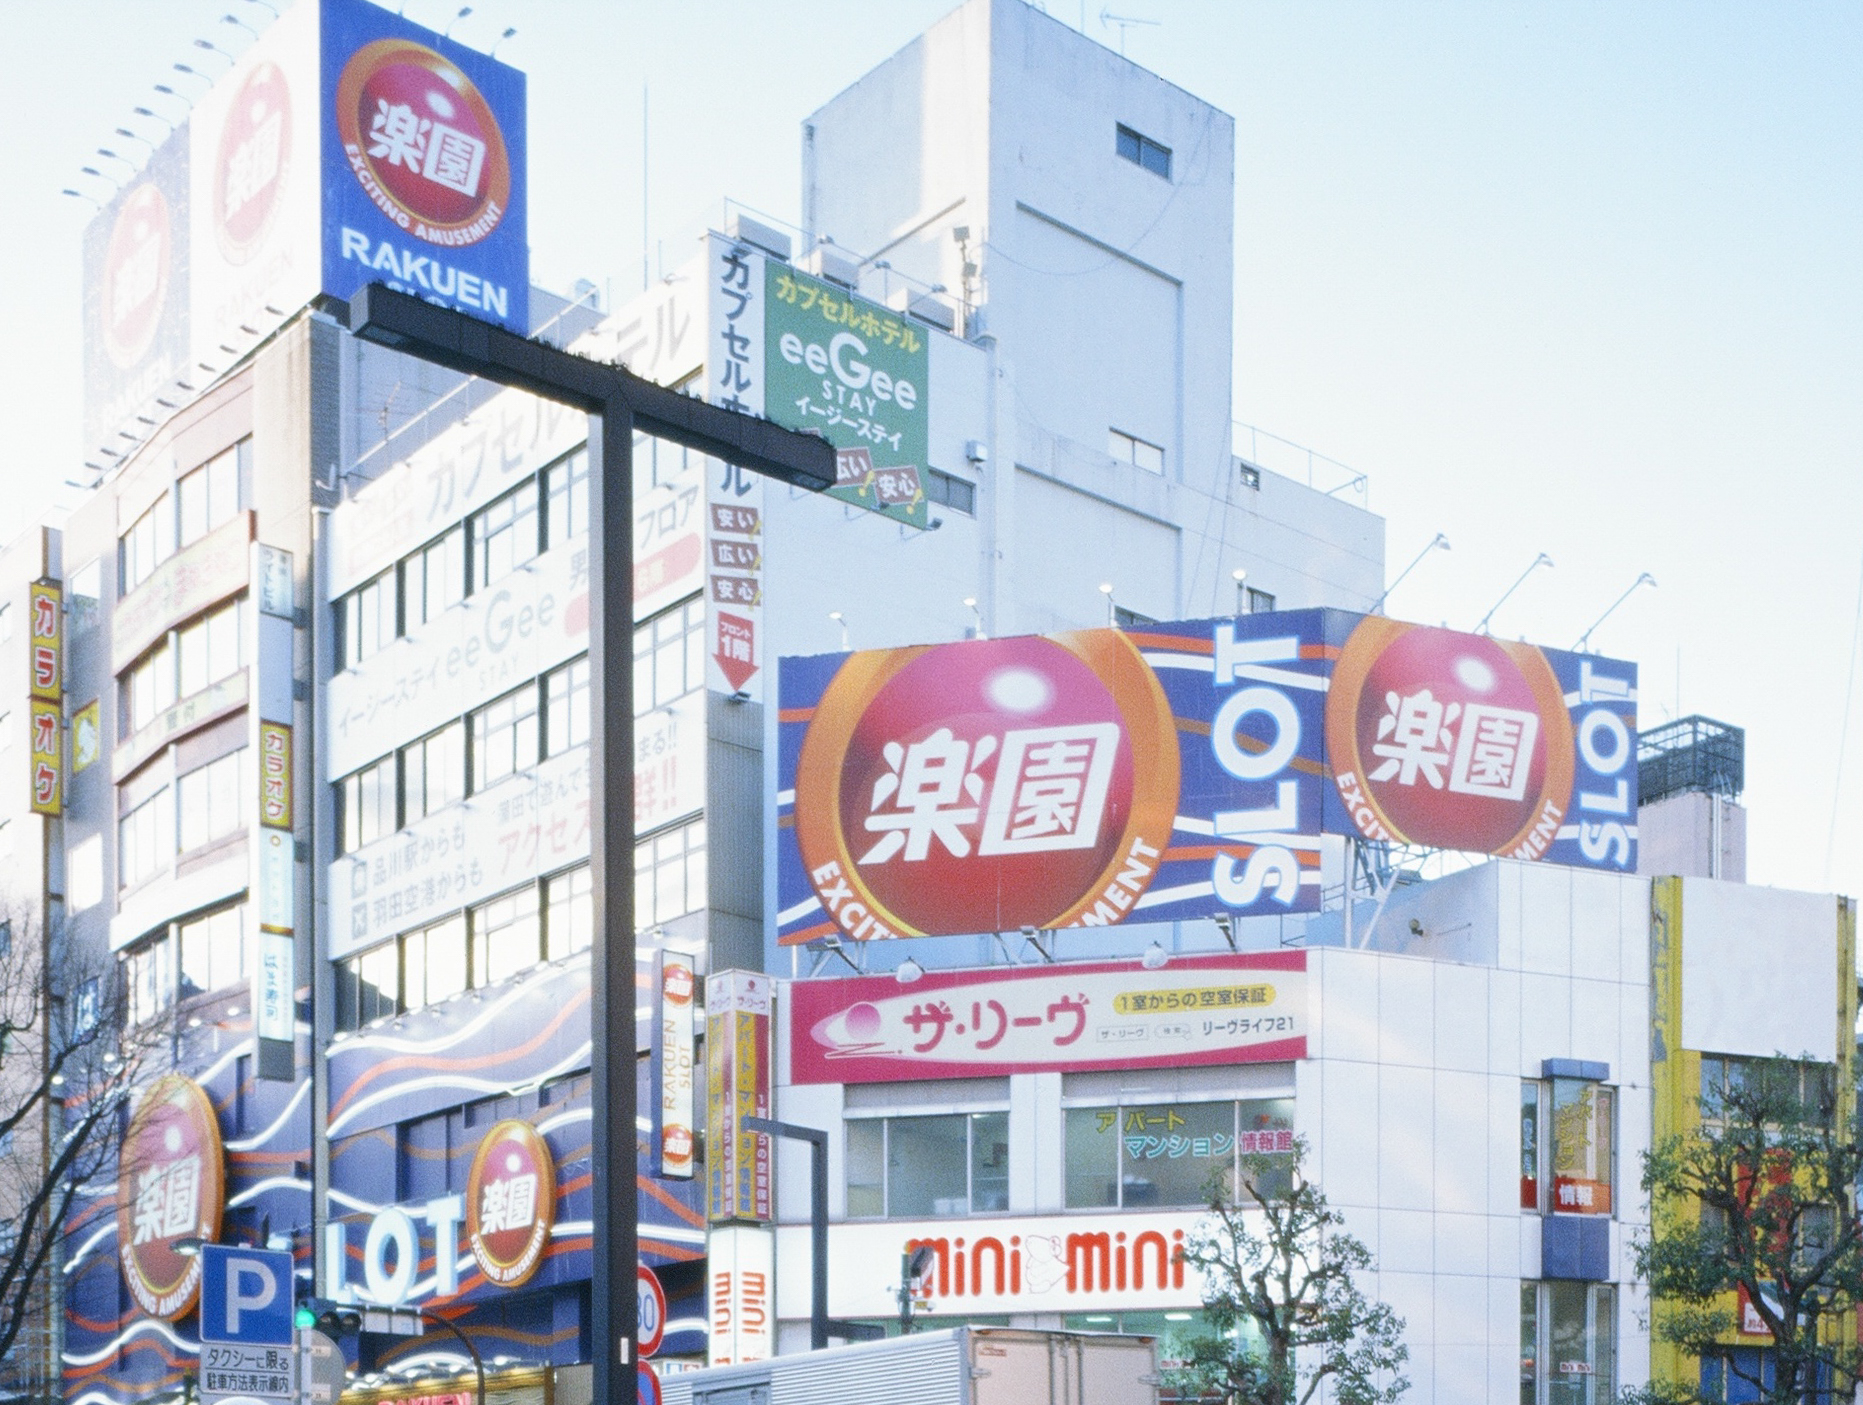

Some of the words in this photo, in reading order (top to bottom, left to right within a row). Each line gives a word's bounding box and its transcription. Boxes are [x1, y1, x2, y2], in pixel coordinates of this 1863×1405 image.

[367, 98, 487, 199] 楽園
[344, 143, 411, 230] EXCITING
[414, 203, 503, 247] AMUSEMENT
[341, 226, 508, 319] RAKUEN
[775, 273, 921, 353] カプセルホテル
[779, 331, 917, 411] eeGee
[821, 379, 877, 417] STAY
[795, 396, 903, 451] イージーステイ
[636, 485, 700, 550] フロア
[445, 589, 556, 679] eeGee
[33, 595, 58, 806] カラオケ
[338, 656, 441, 738] イージーステイ
[478, 652, 521, 692] STAY
[265, 731, 287, 821] カラオケ
[1212, 623, 1300, 908] SLOT
[1367, 688, 1540, 802] 楽園
[1578, 659, 1631, 868] SLOT
[857, 721, 1121, 866] 楽園
[1335, 771, 1397, 841] EXCIT
[1507, 799, 1563, 861] MENT
[372, 821, 465, 887] 品川駅からも
[372, 858, 484, 928] 羽田空港からも
[811, 860, 898, 940] EXCIT
[903, 991, 1091, 1054] ザ・リーヴ
[1120, 986, 1267, 1012] 1室からの空室保証
[1202, 1016, 1295, 1037] リーヴライフ21
[663, 1019, 676, 1110] RAKUEN
[678, 1046, 691, 1090] SLOT
[1095, 1108, 1186, 1134] アパート
[1123, 1132, 1236, 1160] マンション
[1239, 1130, 1294, 1155] 情報館
[132, 1154, 200, 1247] 楽園
[480, 1173, 538, 1236] 楽園
[470, 1232, 501, 1281] EXCITING
[501, 1218, 546, 1282] AMUSEMENT
[1065, 1229, 1186, 1293] mini
[226, 1257, 277, 1334] P
[714, 1271, 732, 1335] mini
[742, 1271, 766, 1335] mini
[206, 1372, 290, 1394] 駐車方法表示線内
[207, 1349, 290, 1372] タクシーに限る
